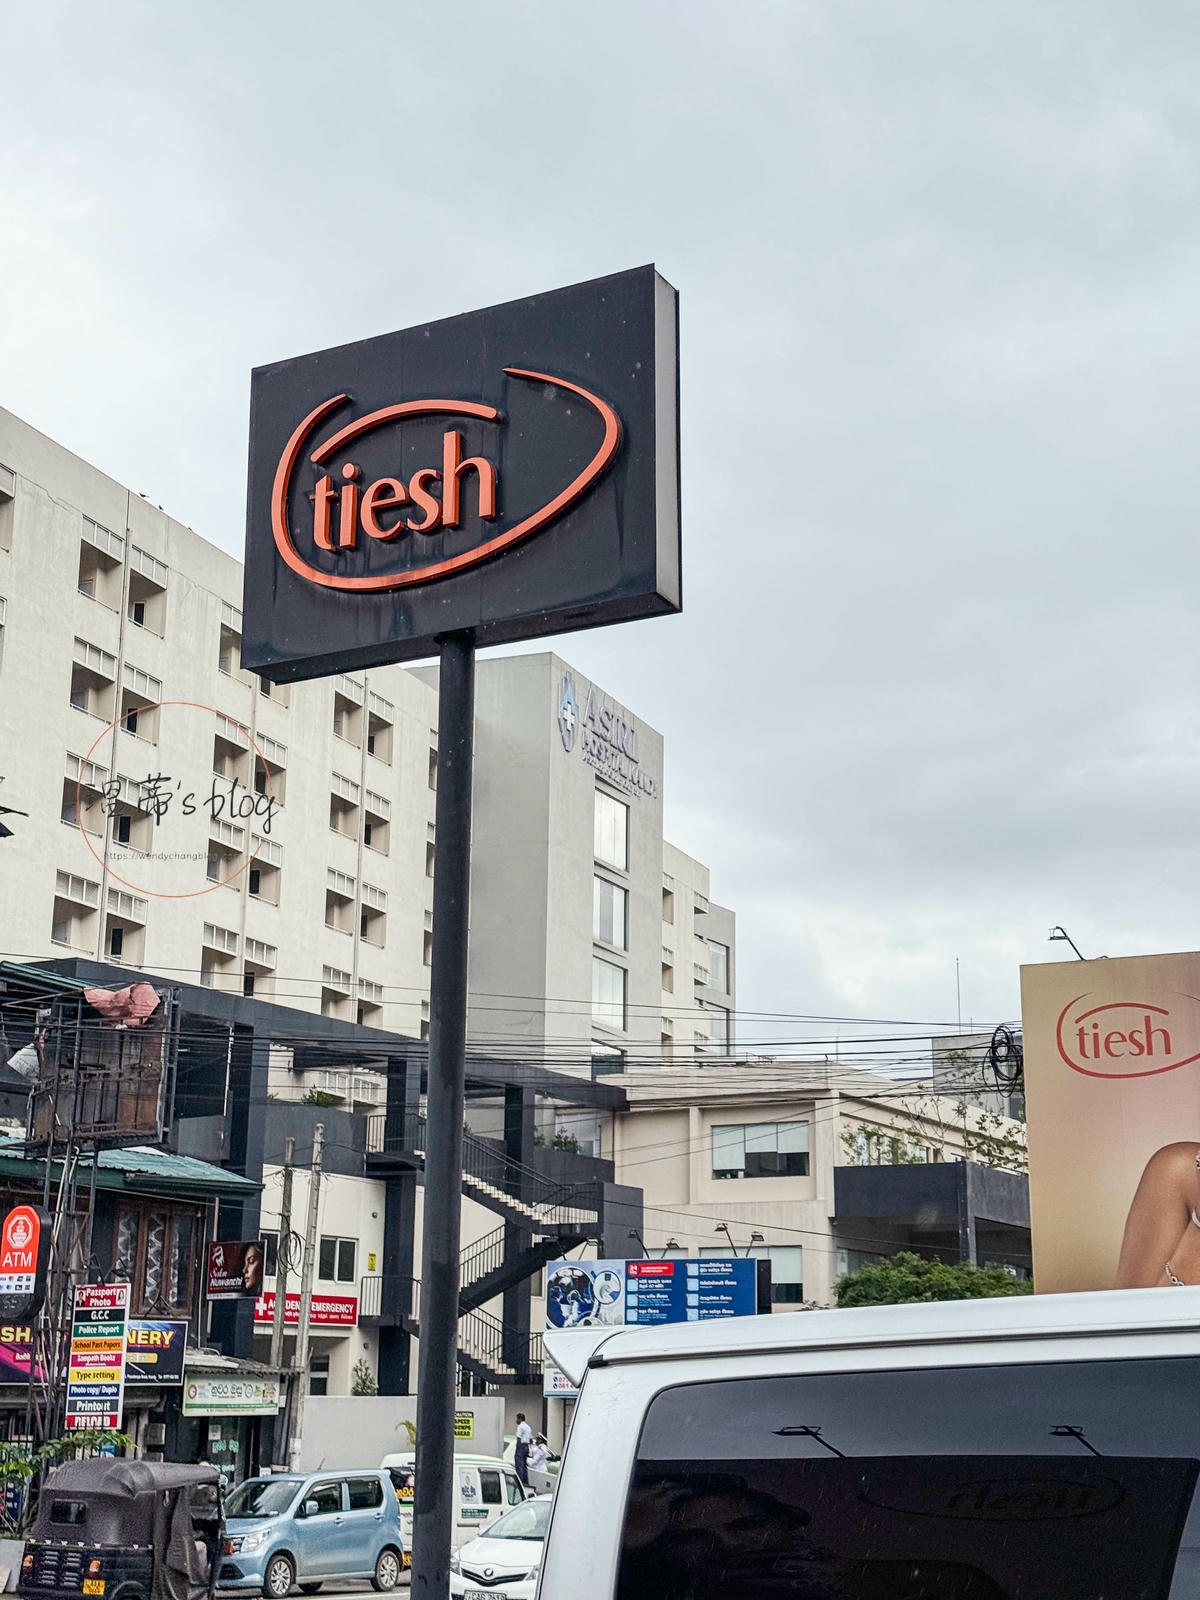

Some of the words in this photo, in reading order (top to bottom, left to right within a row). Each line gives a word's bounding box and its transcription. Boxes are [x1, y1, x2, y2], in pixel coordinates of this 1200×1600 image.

[309, 430, 496, 551] tiesh
[1075, 1015, 1172, 1059] tiesh
[2, 1251, 33, 1268] ATM
[86, 1287, 116, 1298] Passport
[90, 1298, 111, 1306] Photo
[311, 1301, 354, 1314] EMERGENCY
[78, 1325, 97, 1334] Police
[98, 1325, 120, 1335] Report
[74, 1341, 91, 1349] School
[104, 1340, 120, 1350] Papers
[76, 1372, 92, 1380] Type
[92, 1371, 115, 1380] setting
[71, 1385, 87, 1394] Photo
[76, 1400, 111, 1411] Printout
